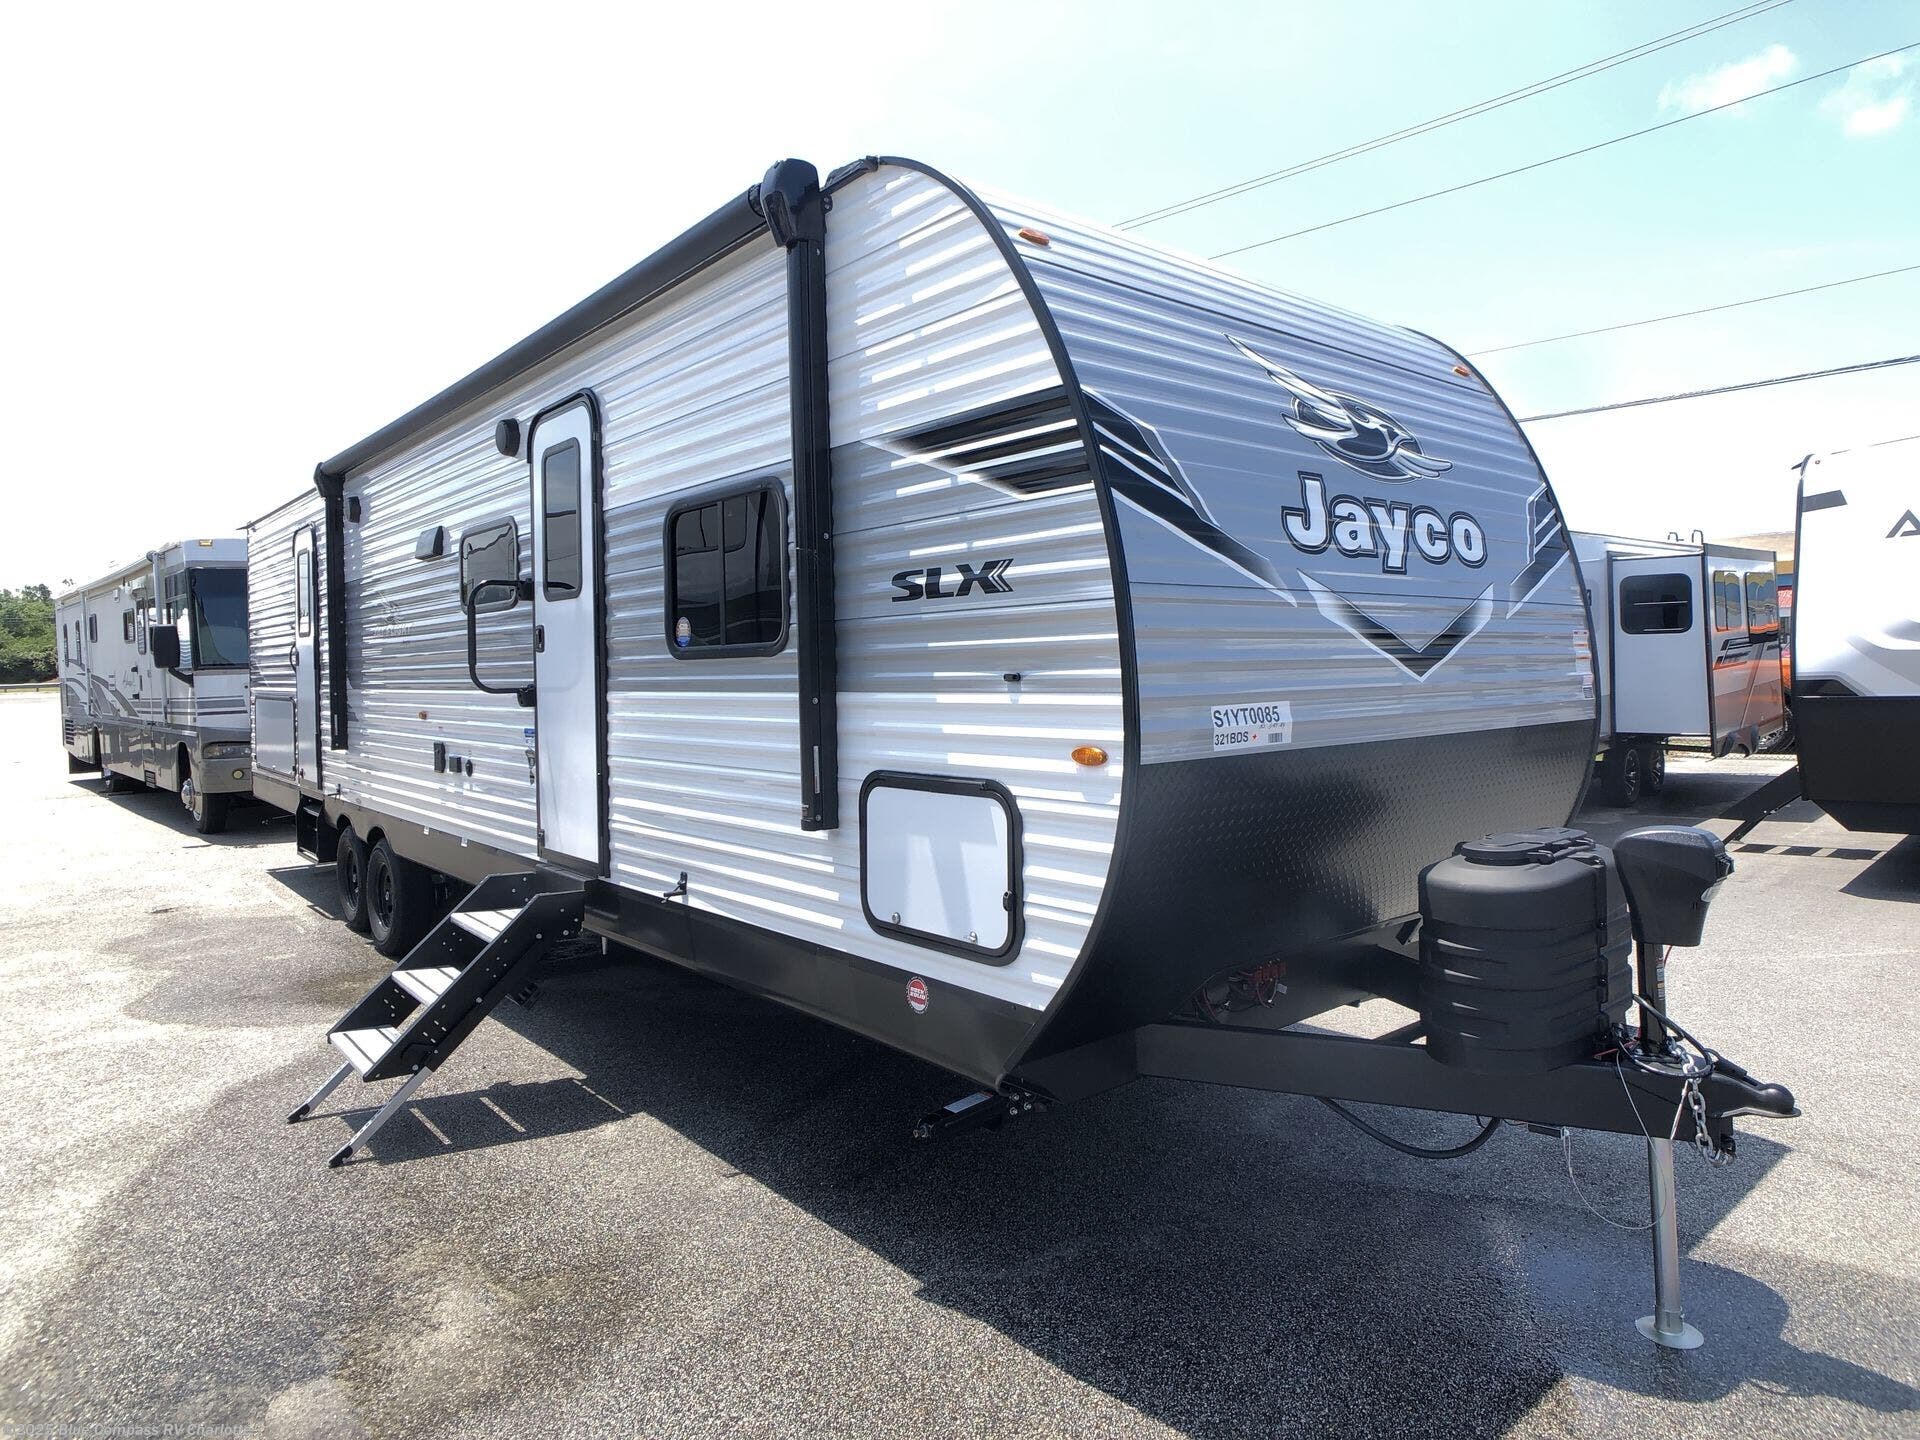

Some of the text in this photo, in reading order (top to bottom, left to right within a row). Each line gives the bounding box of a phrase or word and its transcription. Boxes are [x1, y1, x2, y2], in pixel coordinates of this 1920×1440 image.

[1281, 471, 1488, 575] Jayco
[892, 558, 1014, 602] SLX
[1213, 706, 1280, 727] S1YT0085
[1214, 731, 1249, 746] 321BDS
